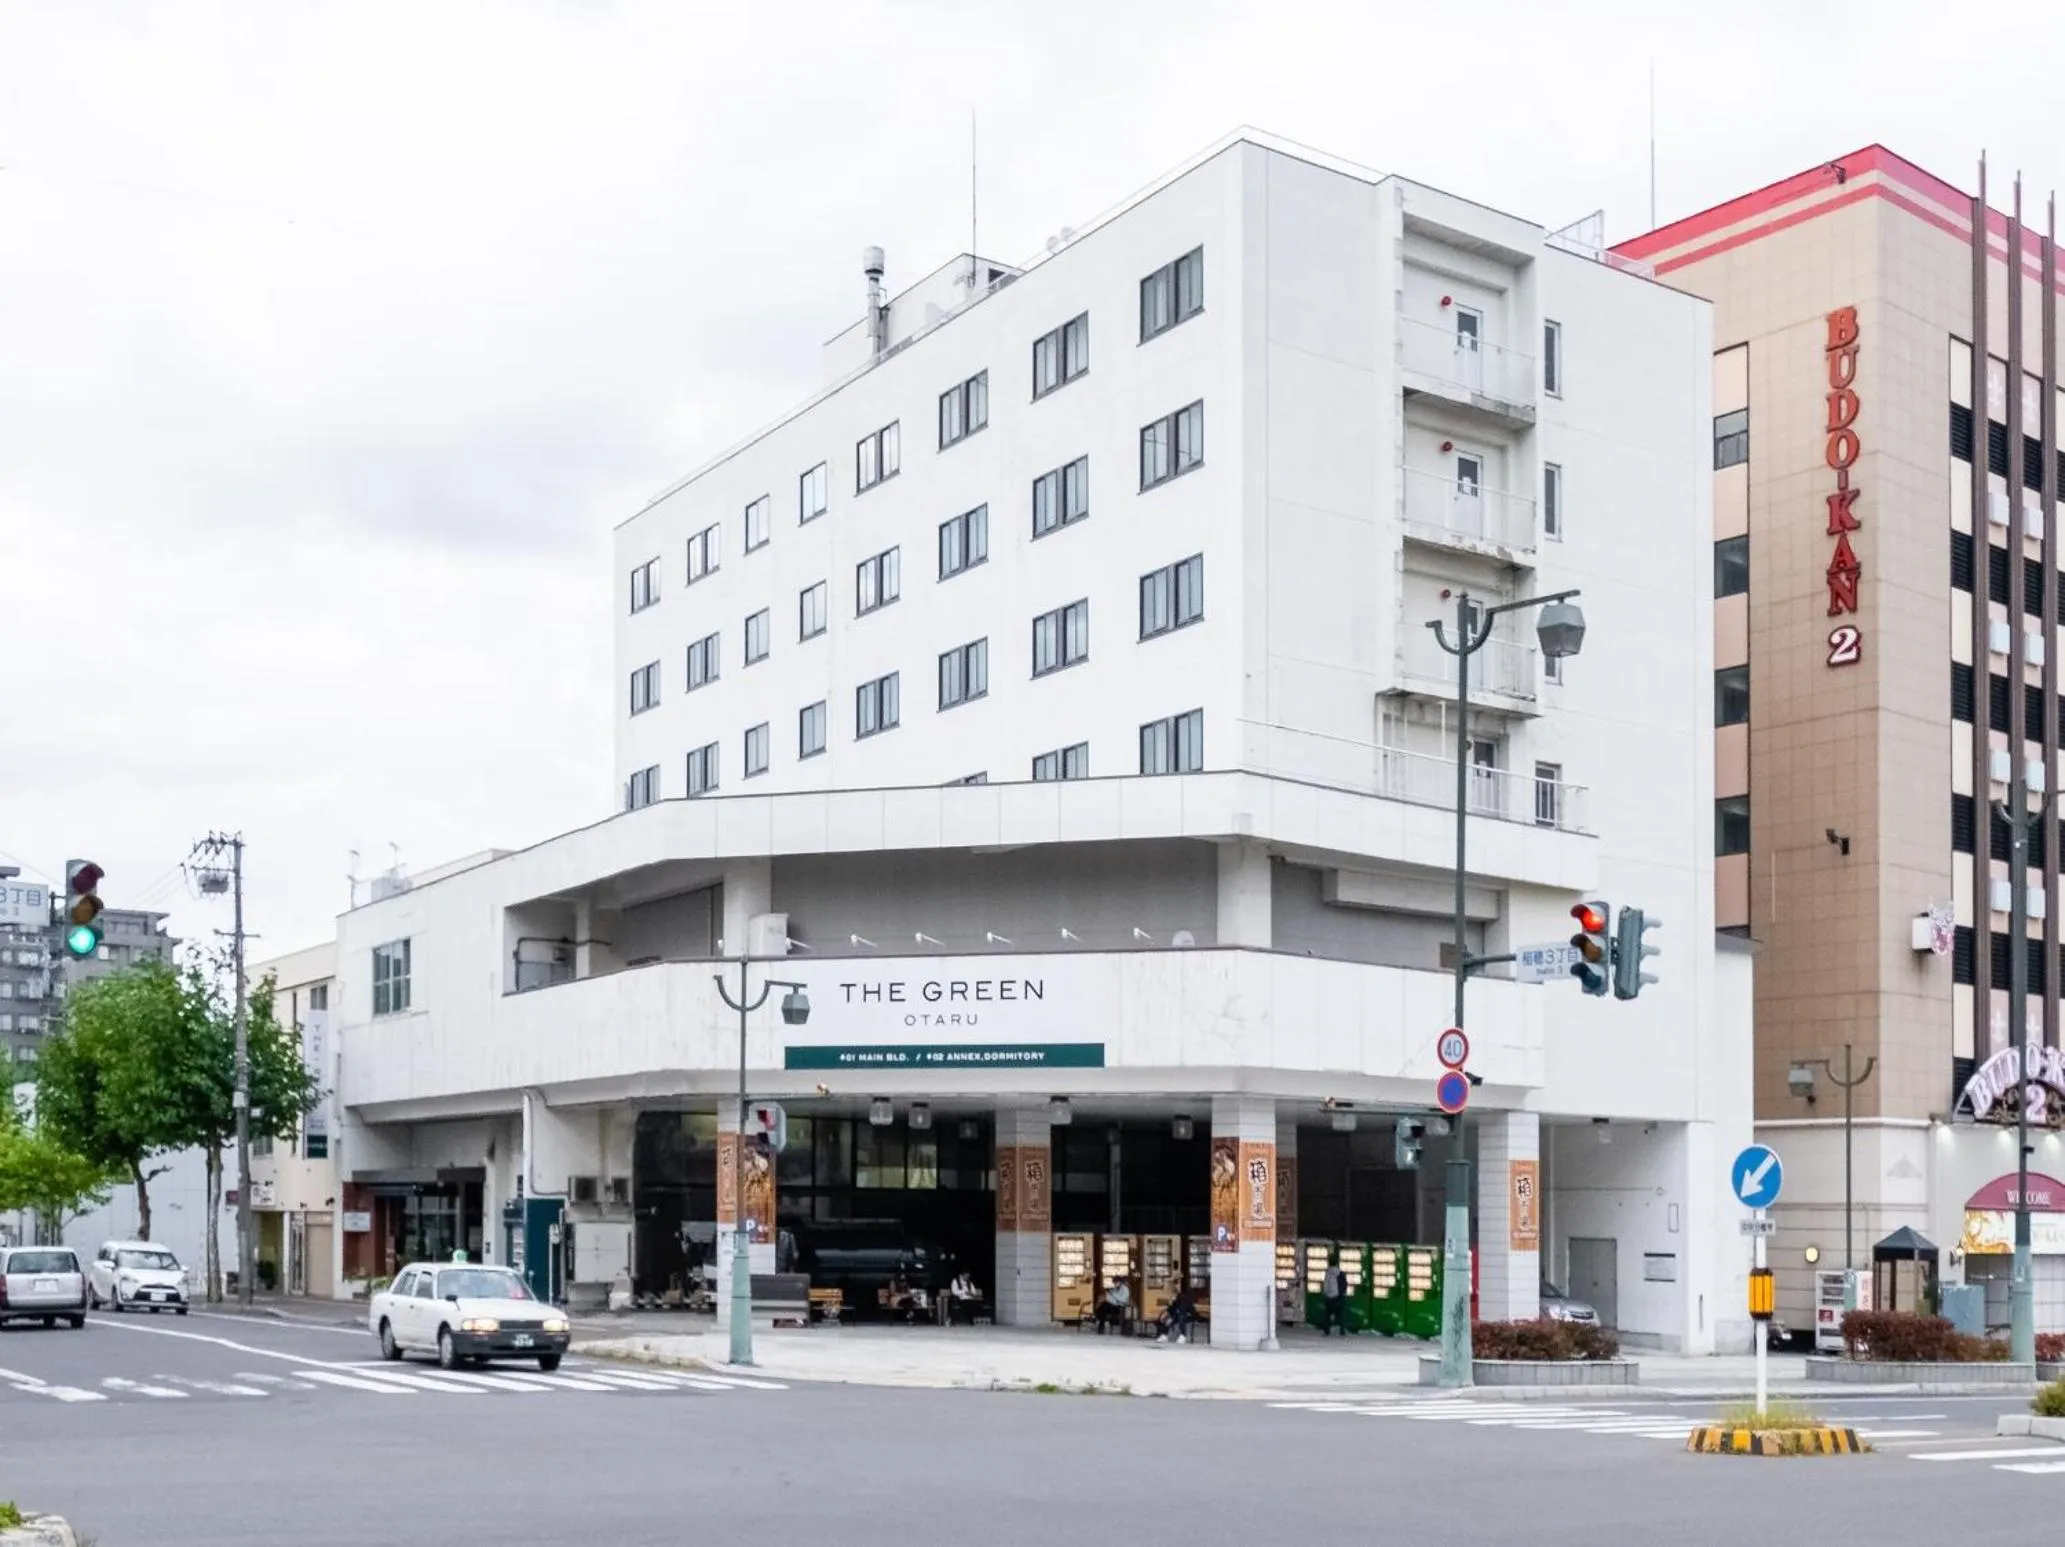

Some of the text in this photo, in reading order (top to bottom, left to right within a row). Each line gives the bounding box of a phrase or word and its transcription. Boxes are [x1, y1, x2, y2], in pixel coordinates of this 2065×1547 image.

[1827, 625, 1861, 667] 2
[840, 979, 1044, 1003] THE GREEN
[904, 1013, 978, 1026] OTARU
[1444, 1039, 1462, 1057] 40
[858, 1053, 884, 1062] MAIN
[886, 1053, 910, 1062] BLD.
[2025, 1084, 2047, 1124] 2
[1217, 1225, 1227, 1242] P
